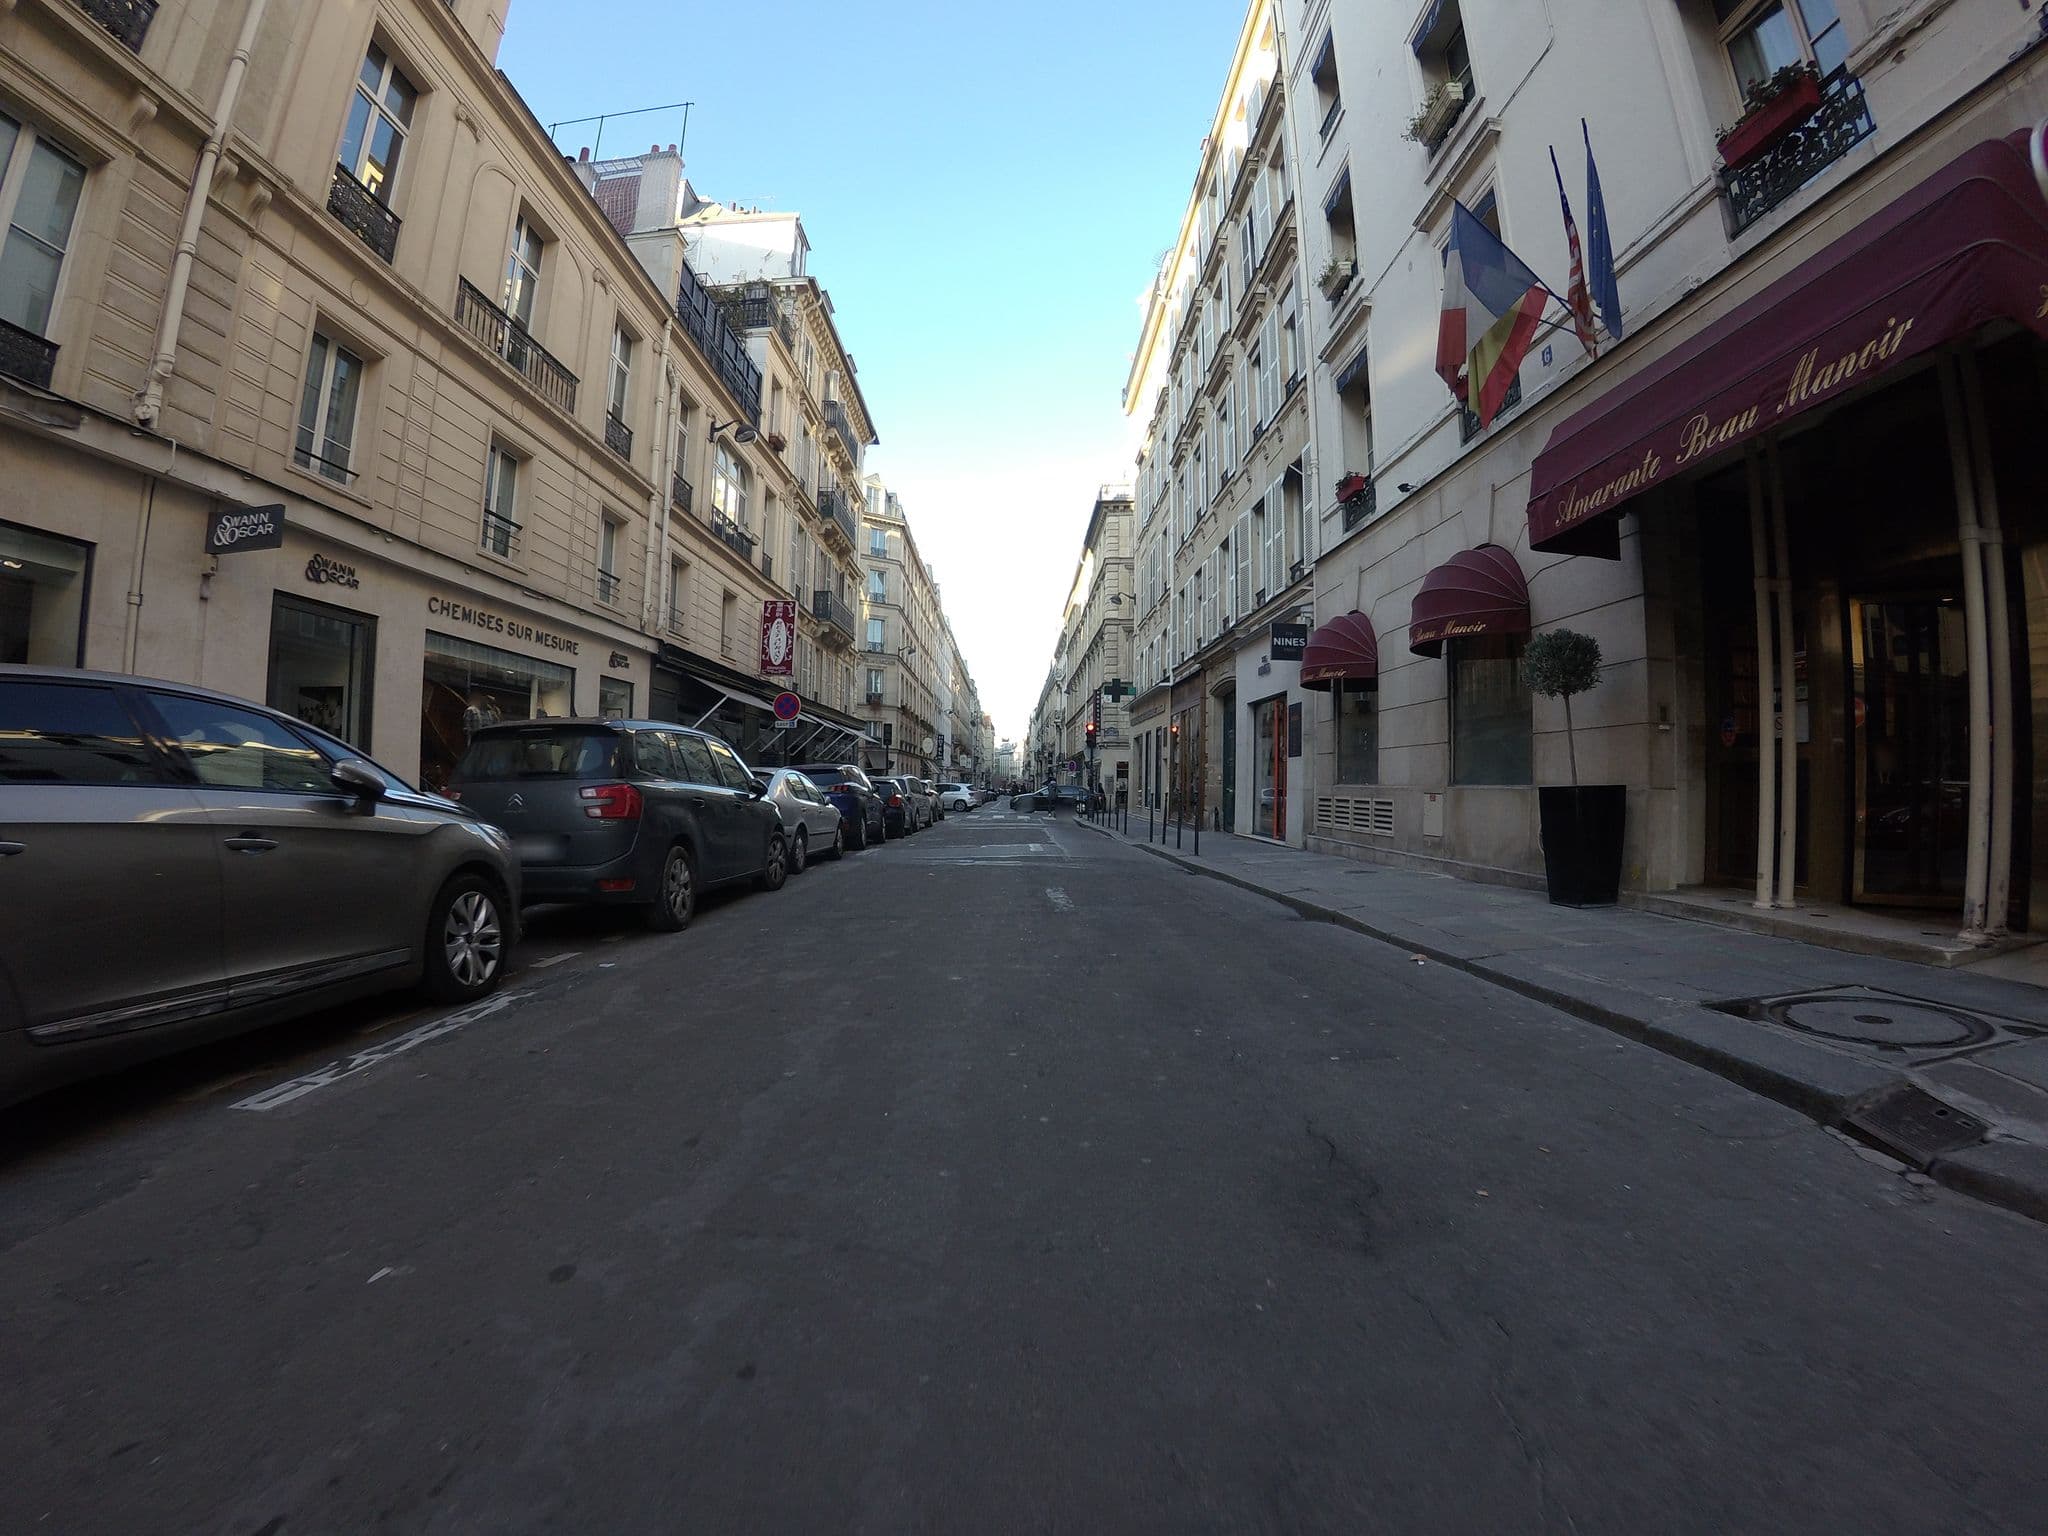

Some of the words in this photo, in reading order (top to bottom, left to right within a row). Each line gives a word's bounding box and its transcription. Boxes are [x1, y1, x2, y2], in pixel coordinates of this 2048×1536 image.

[1554, 446, 1663, 527] Amarante
[1674, 404, 1760, 466] Beau
[1775, 315, 1915, 414] Manoir
[221, 512, 270, 532] SWANN
[313, 553, 356, 577] SWANN
[427, 596, 504, 634] CHEMISES
[507, 621, 533, 644] SUR
[535, 630, 579, 656] MESURE
[1441, 617, 1487, 636] Manoir
[1273, 637, 1306, 647] NINES
